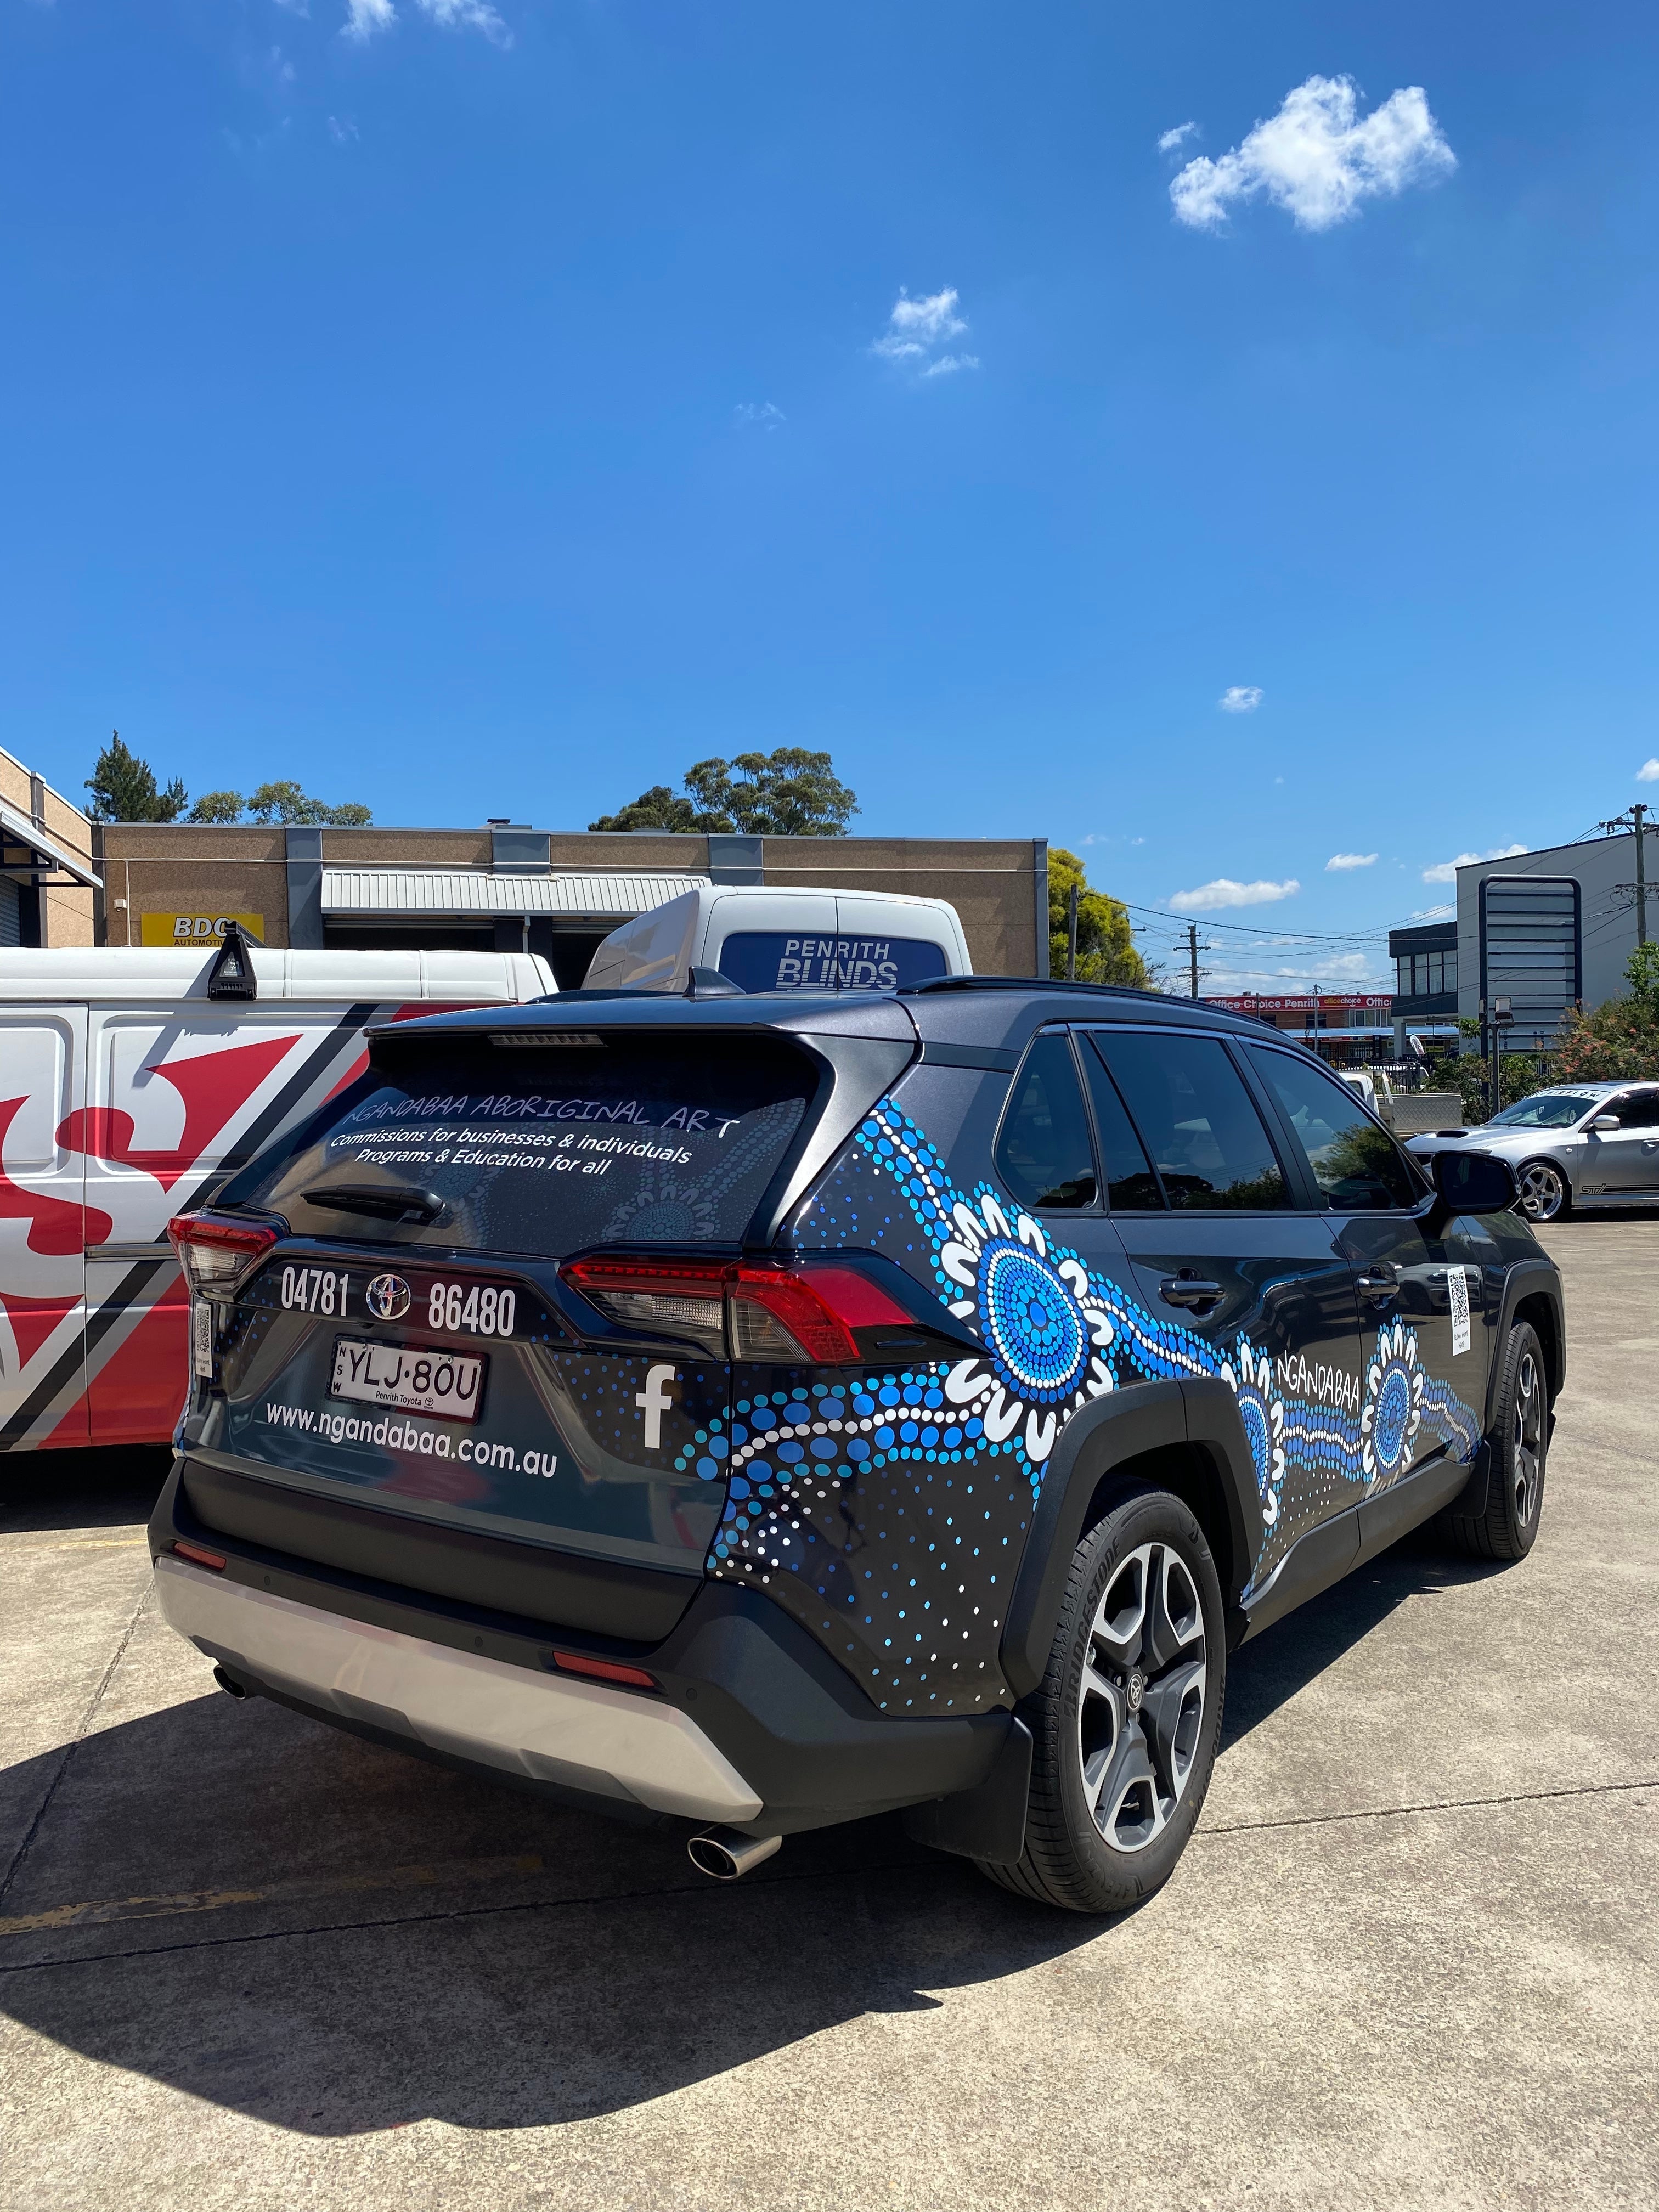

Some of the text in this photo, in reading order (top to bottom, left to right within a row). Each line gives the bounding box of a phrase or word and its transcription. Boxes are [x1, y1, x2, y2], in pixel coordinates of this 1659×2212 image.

[785, 939, 890, 960] PENRITH
[776, 958, 899, 990] BLINDS
[1243, 999, 1281, 1008] Choice
[1365, 997, 1392, 1007] Offic
[342, 1094, 741, 1138] NGANDABAA ABORIGINAL ART
[330, 1128, 693, 1164] Commissions for businesses & individuals
[354, 1148, 612, 1176] Programs & Education for all
[281, 1266, 349, 1317] 04781
[428, 1283, 516, 1337] 86480
[376, 1390, 422, 1406] Penrith Toyota
[1277, 1350, 1359, 1413] NGANDABAA
[266, 1402, 558, 1478] www.ngandabaa.com.au
